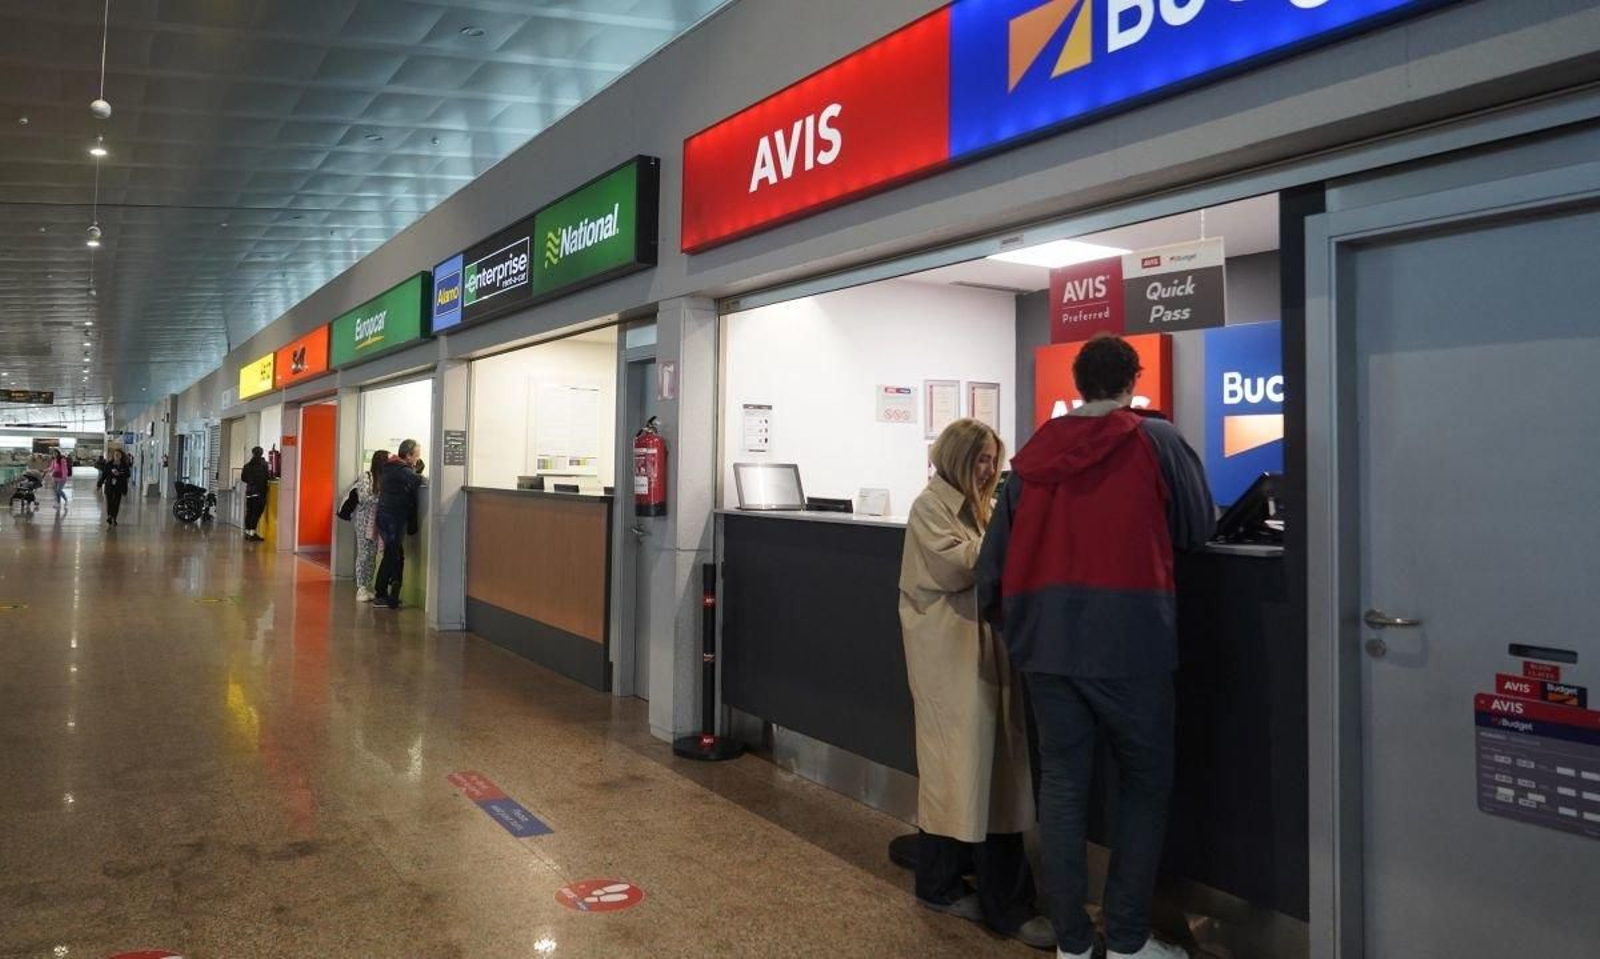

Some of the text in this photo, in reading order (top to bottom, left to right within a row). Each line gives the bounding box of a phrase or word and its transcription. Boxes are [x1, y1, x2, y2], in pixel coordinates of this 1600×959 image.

[749, 103, 842, 193] AVIS
[560, 203, 619, 258] National
[466, 252, 528, 293] enterprise
[437, 286, 459, 306] Alamo
[1062, 276, 1107, 303] AVIS
[1146, 275, 1196, 301] Quick
[1062, 306, 1110, 323] Preferred
[1149, 305, 1191, 323] Pass
[355, 310, 387, 342] Europcar
[1504, 681, 1530, 693] AVIS
[1491, 699, 1524, 714] AVIS
[1501, 718, 1533, 732] Budget
